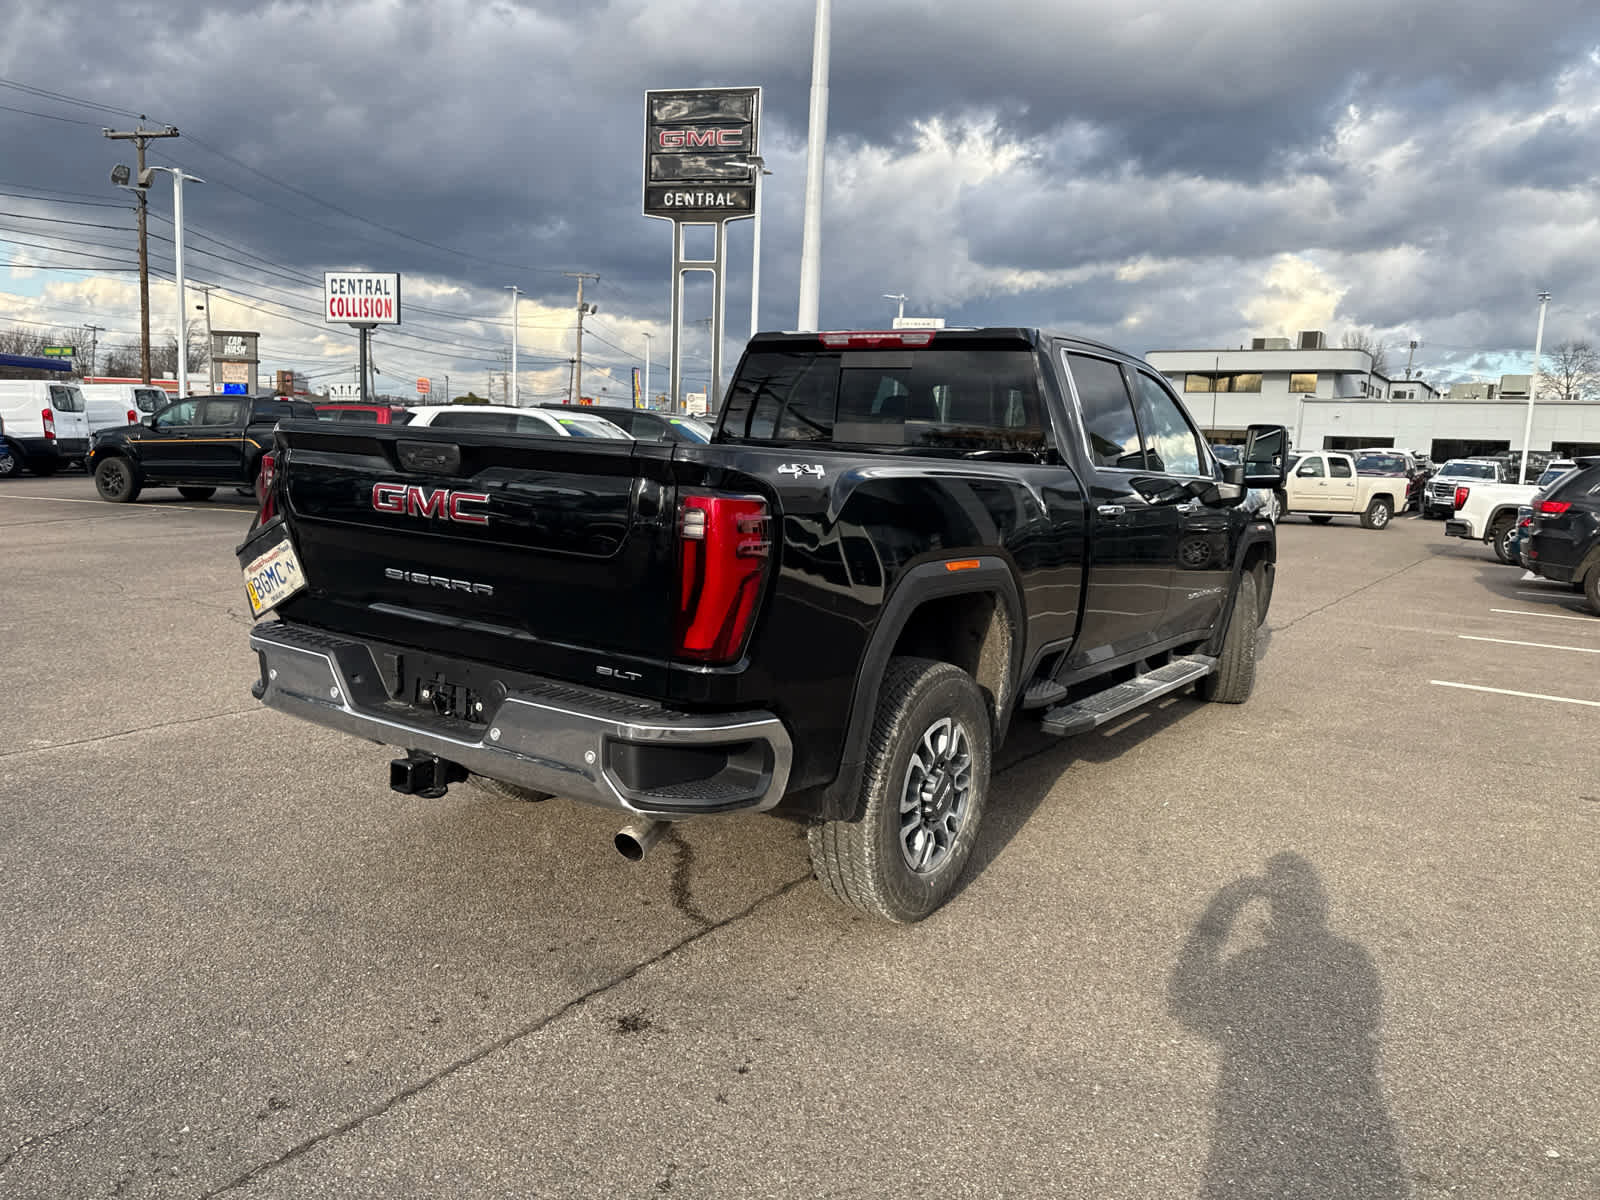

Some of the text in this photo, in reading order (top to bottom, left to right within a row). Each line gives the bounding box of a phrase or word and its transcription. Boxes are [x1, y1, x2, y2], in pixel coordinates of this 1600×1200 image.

[660, 130, 742, 146] GMC
[664, 192, 734, 206] CENTRAL
[331, 279, 390, 295] CENTRAL
[330, 298, 391, 318] COLLISION
[227, 336, 243, 346] CAR
[224, 346, 246, 355] WASH
[373, 482, 490, 524] GMC
[384, 567, 494, 596] SIERRA
[595, 665, 643, 681] SLT
